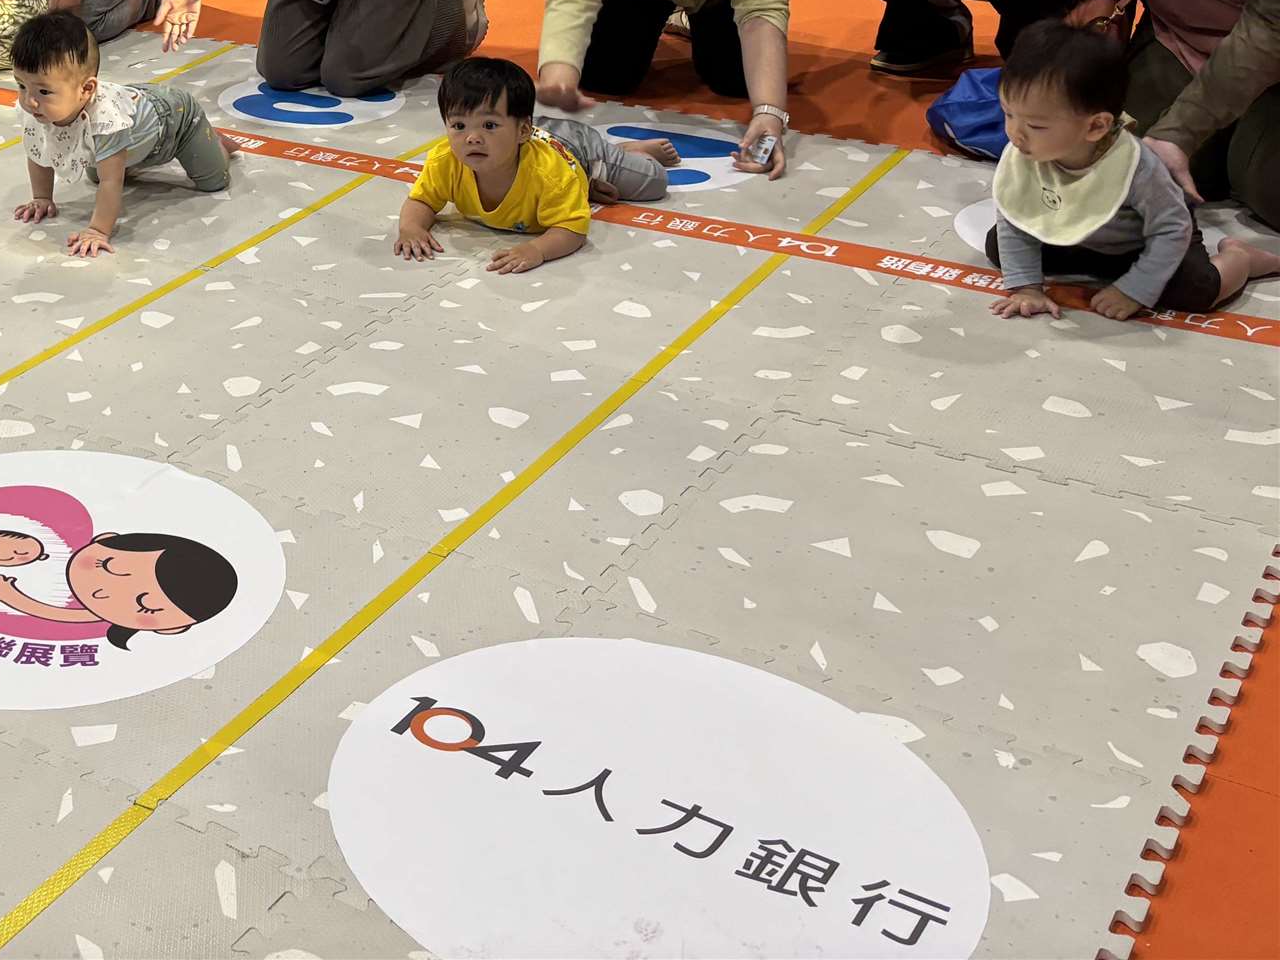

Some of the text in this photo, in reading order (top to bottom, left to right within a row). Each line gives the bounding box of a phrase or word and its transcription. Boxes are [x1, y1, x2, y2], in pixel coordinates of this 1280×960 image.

[631, 211, 841, 257] 104人力銀行
[390, 696, 951, 946] 104人力銀行
